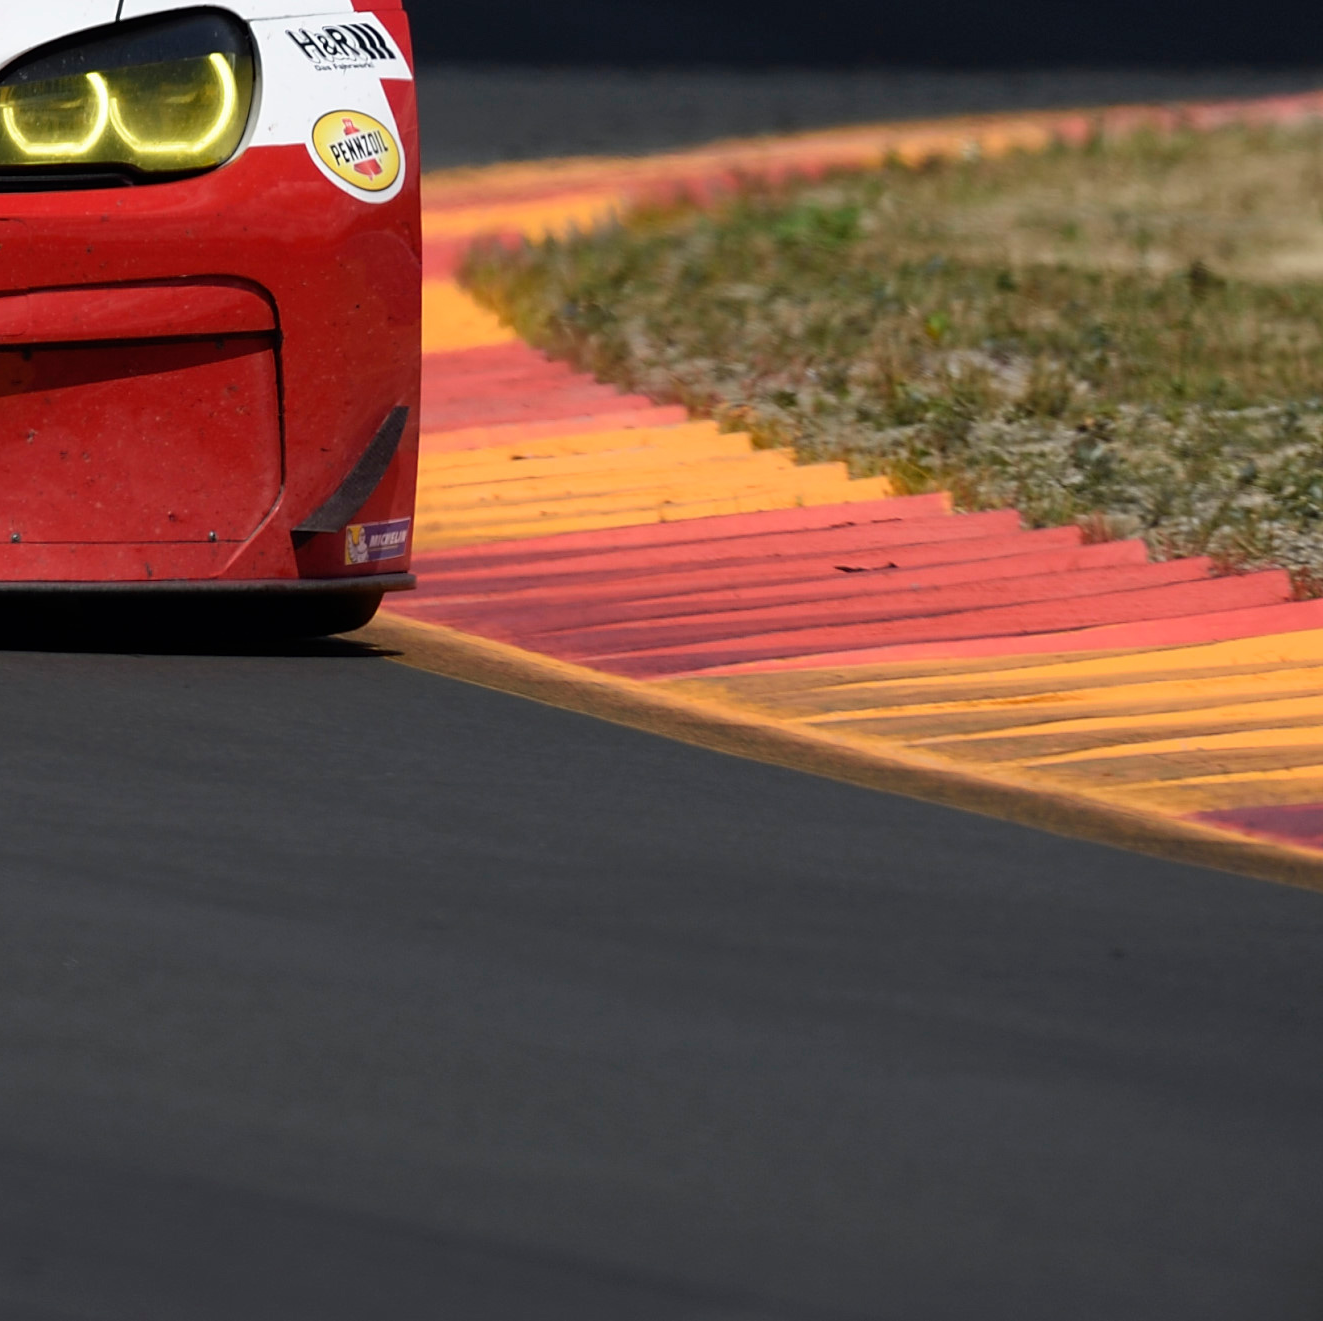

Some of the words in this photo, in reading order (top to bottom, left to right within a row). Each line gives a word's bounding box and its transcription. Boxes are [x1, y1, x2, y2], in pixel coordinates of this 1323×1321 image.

[285, 26, 363, 62] H&R
[329, 130, 389, 167] PENNZOIL
[368, 529, 408, 548] MICHELIN
